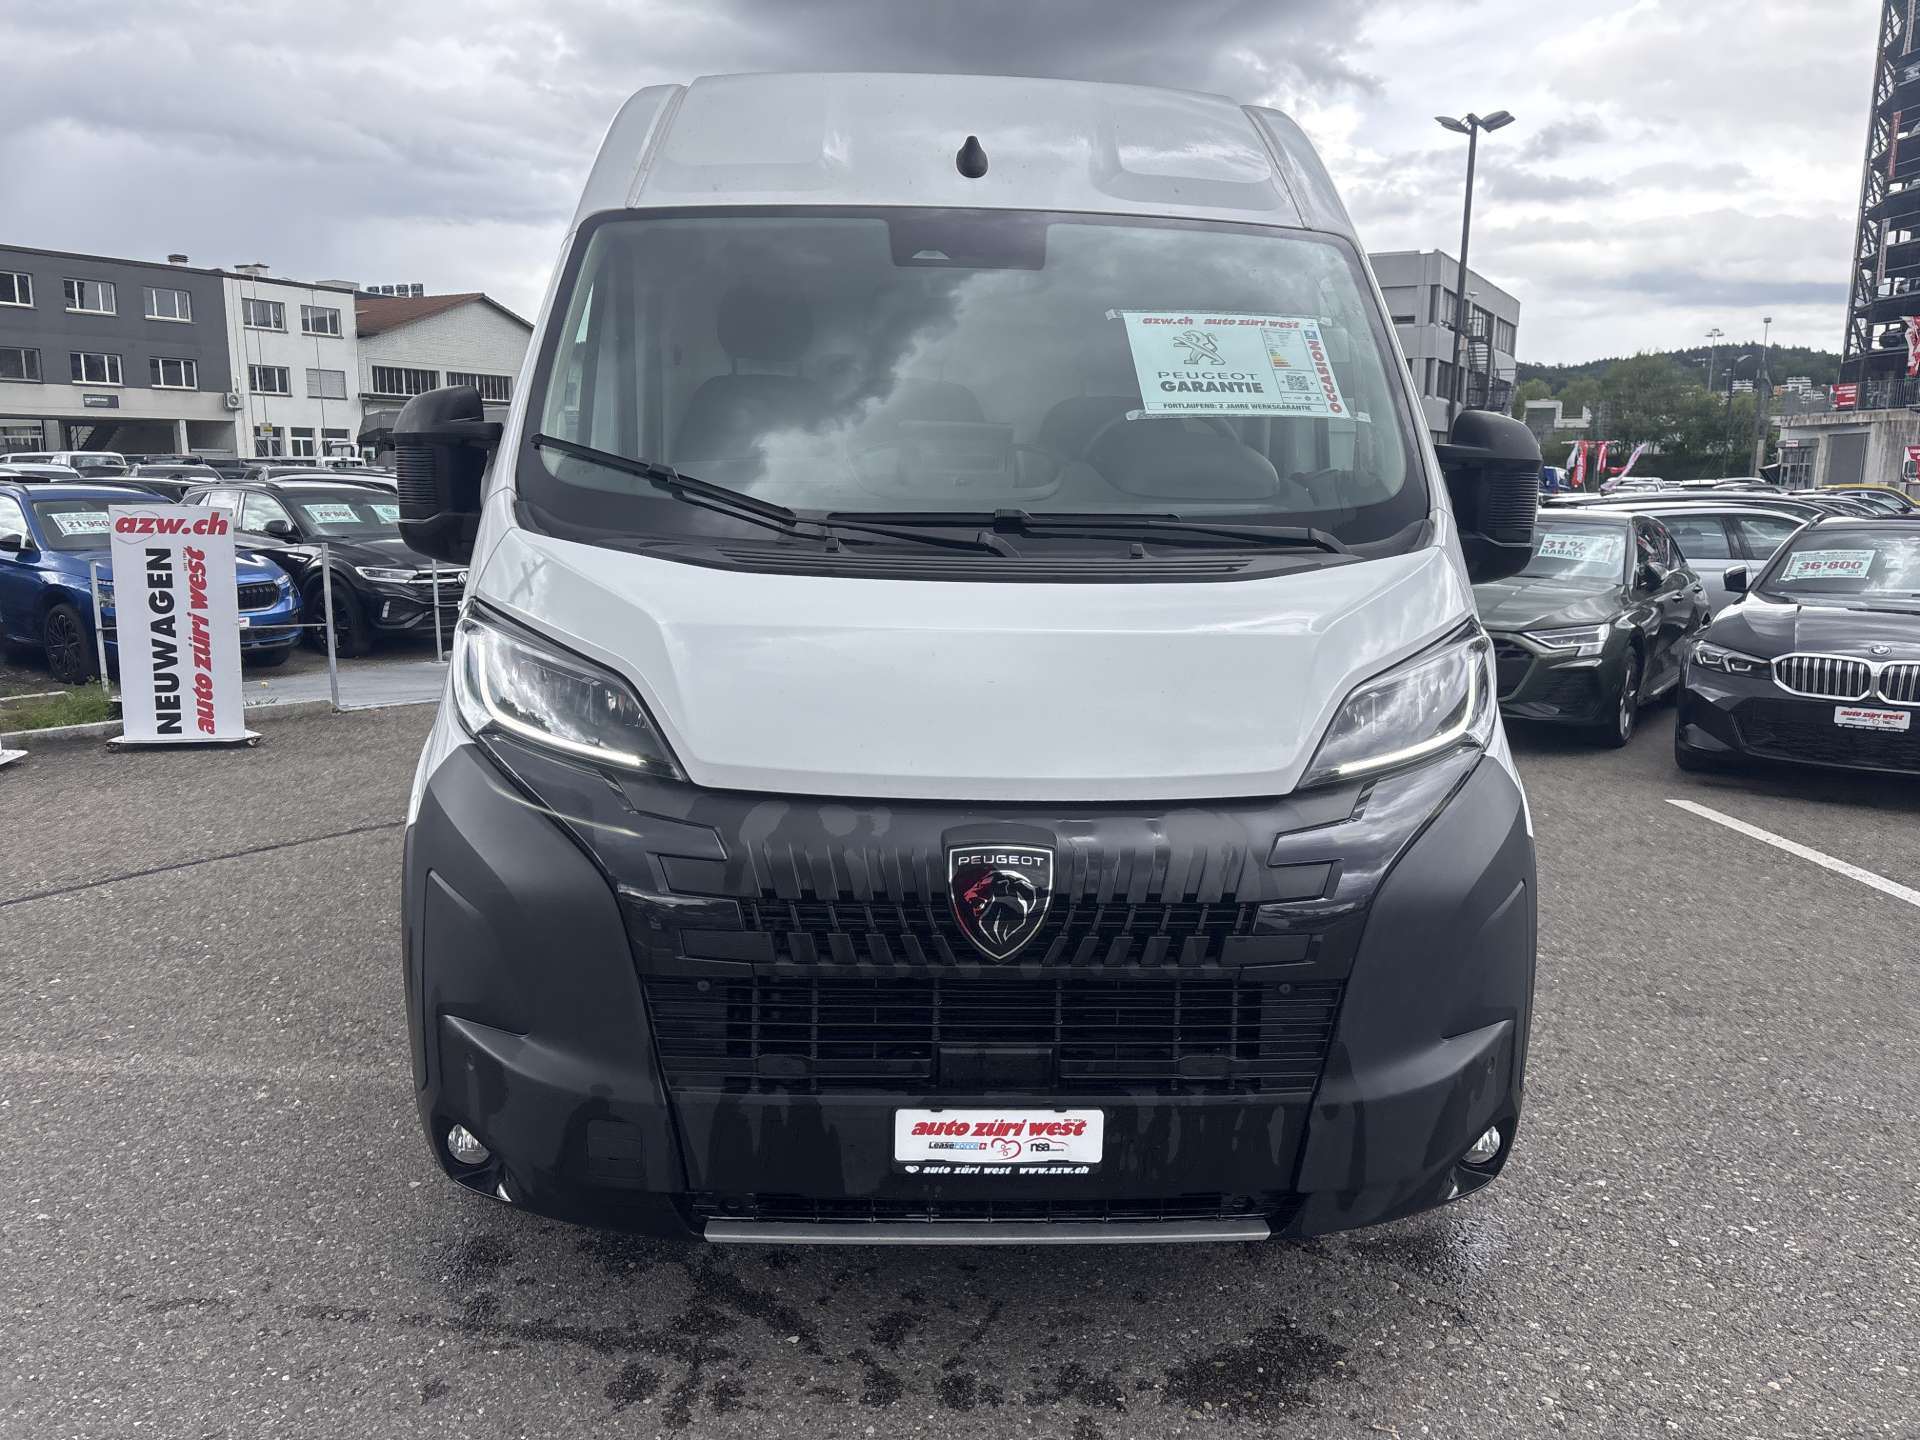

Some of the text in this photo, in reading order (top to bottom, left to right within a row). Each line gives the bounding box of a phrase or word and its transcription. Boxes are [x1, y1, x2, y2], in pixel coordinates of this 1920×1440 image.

[1142, 316, 1193, 325] azw.ch
[1204, 318, 1236, 326] auto
[1268, 320, 1300, 329] west
[1158, 371, 1258, 380] PEUGEOT
[1307, 340, 1343, 414] OCCASION
[1160, 381, 1265, 394] GARANTIE
[114, 511, 229, 536] azw.ch
[1543, 540, 1586, 551] 31%
[1800, 561, 1863, 570] 36'800
[145, 548, 183, 735] NEUWAGEN
[184, 546, 216, 735] auto züri west
[958, 855, 1044, 867] PEUGEOT
[911, 1119, 1088, 1137] auto züri west
[1030, 1142, 1050, 1152] nsa
[923, 1165, 1090, 1175] auto züri west www.azw.ch
